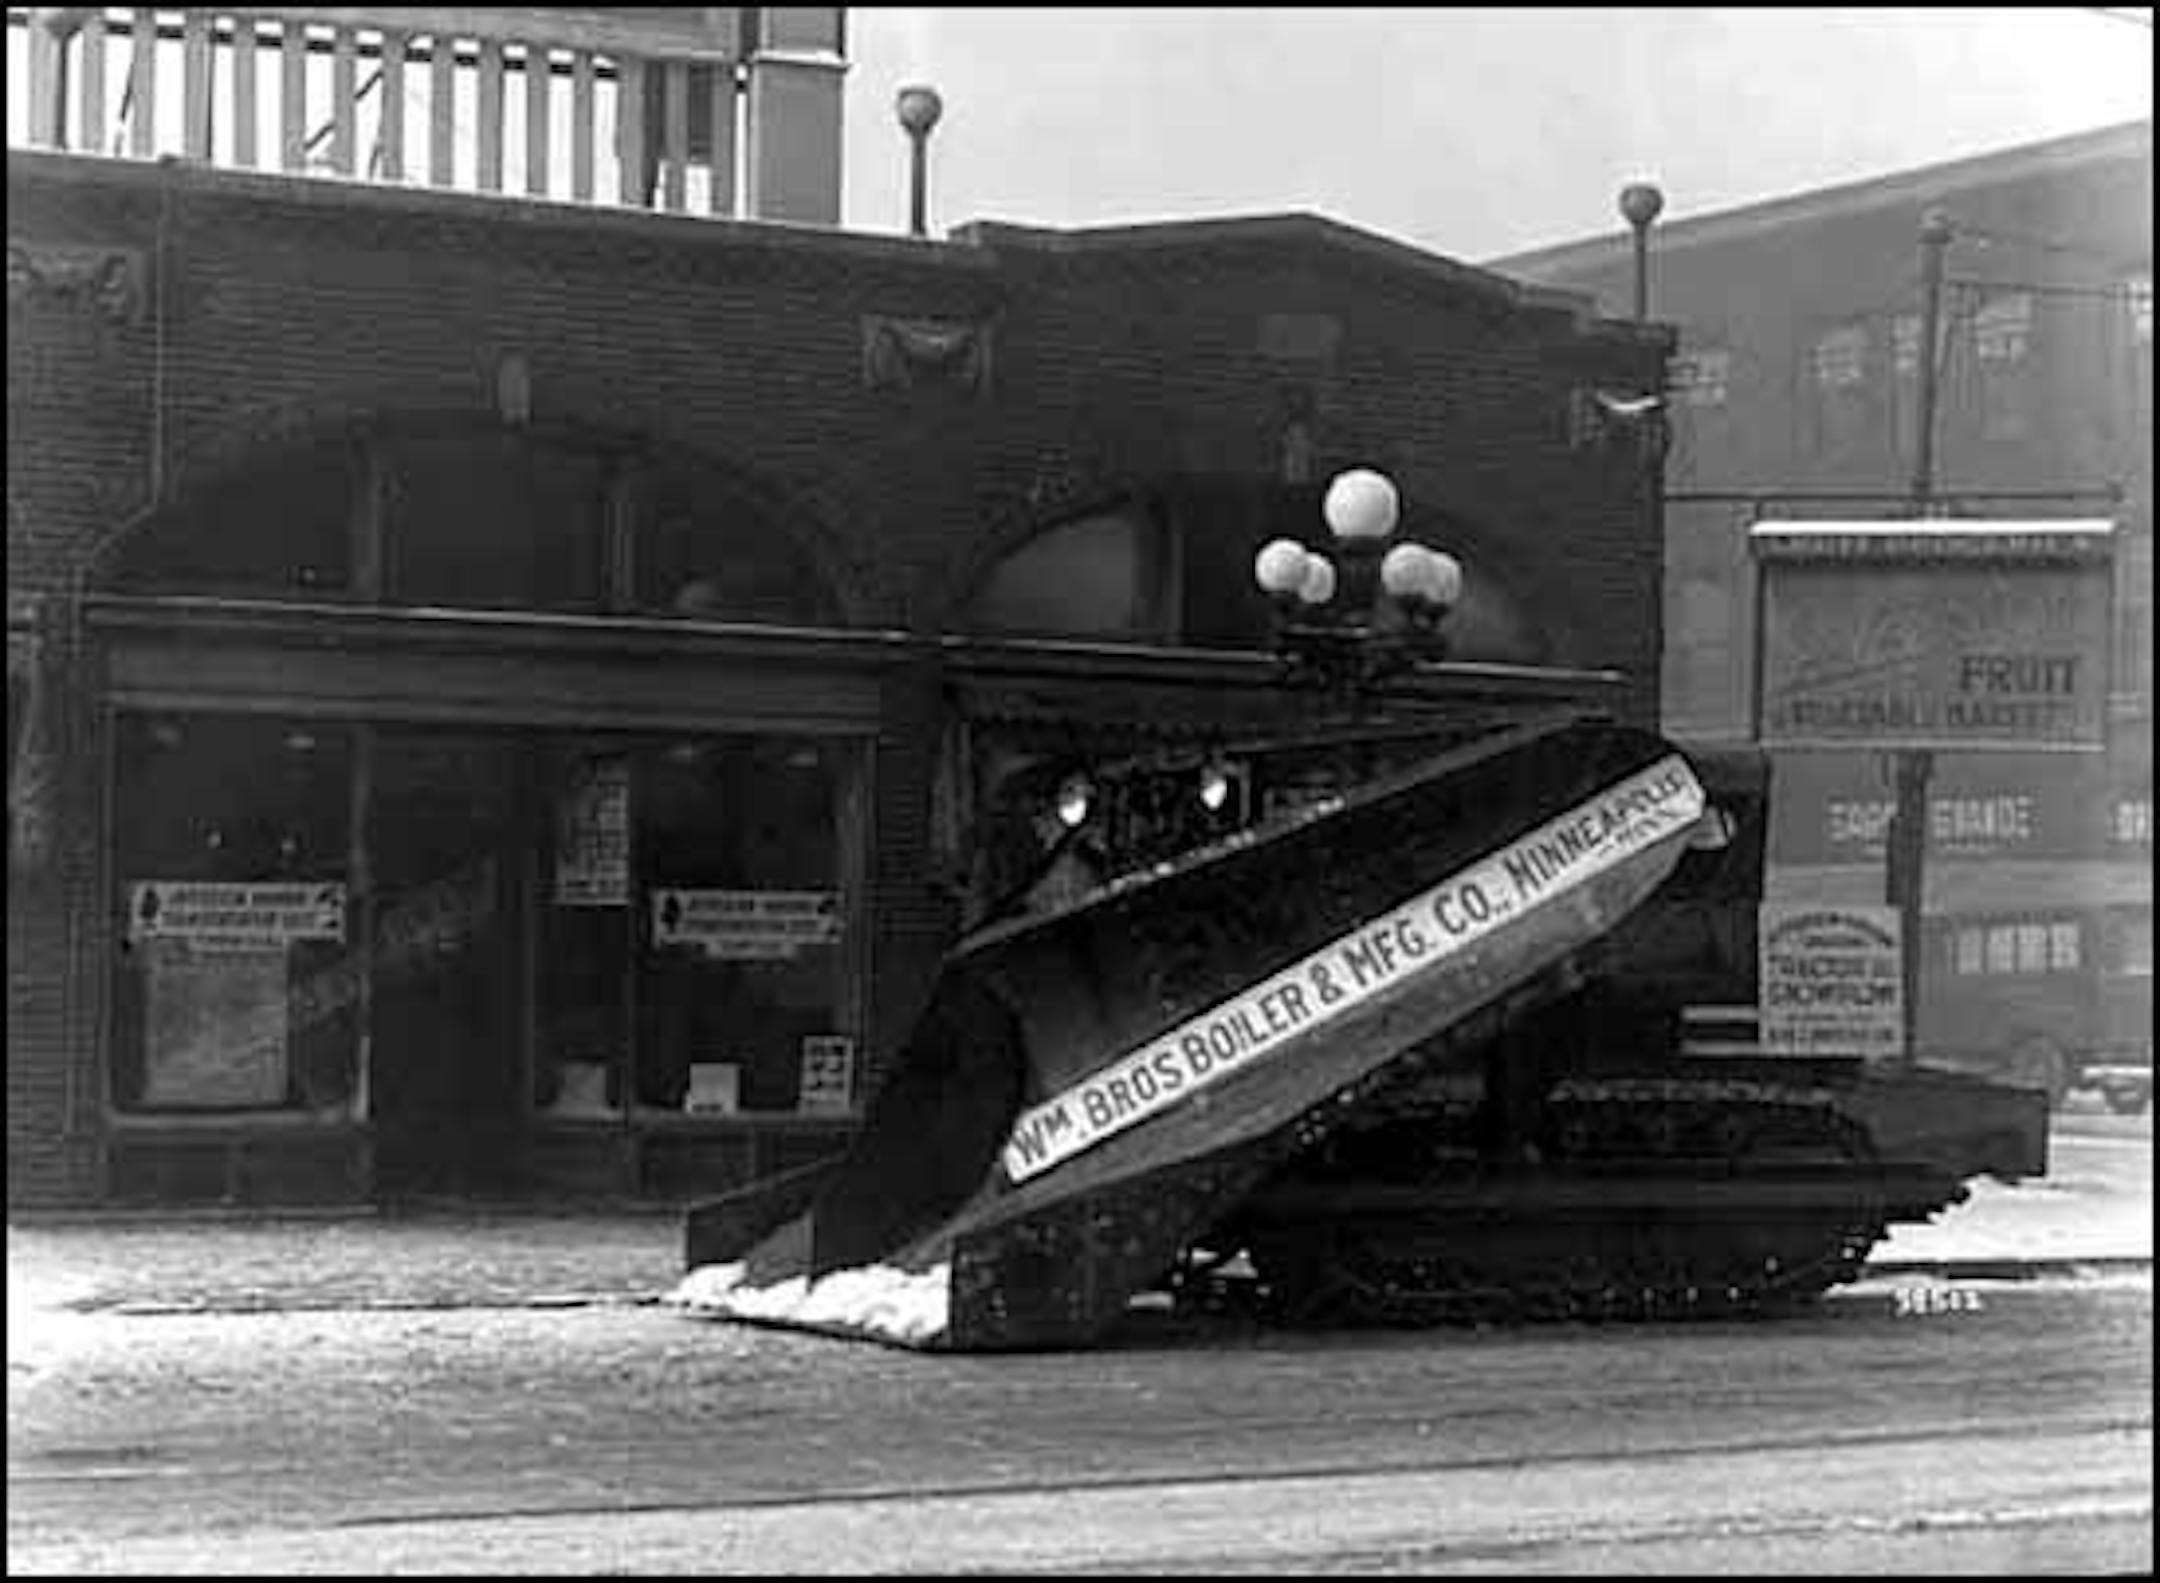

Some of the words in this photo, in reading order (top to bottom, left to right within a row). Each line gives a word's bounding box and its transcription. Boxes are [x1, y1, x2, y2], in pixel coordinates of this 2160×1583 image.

[1960, 655, 2077, 692] FRUIT
[1083, 1052, 1183, 1130] BROS
[1181, 983, 1312, 1076] BOILER
[1309, 963, 1345, 1005] &
